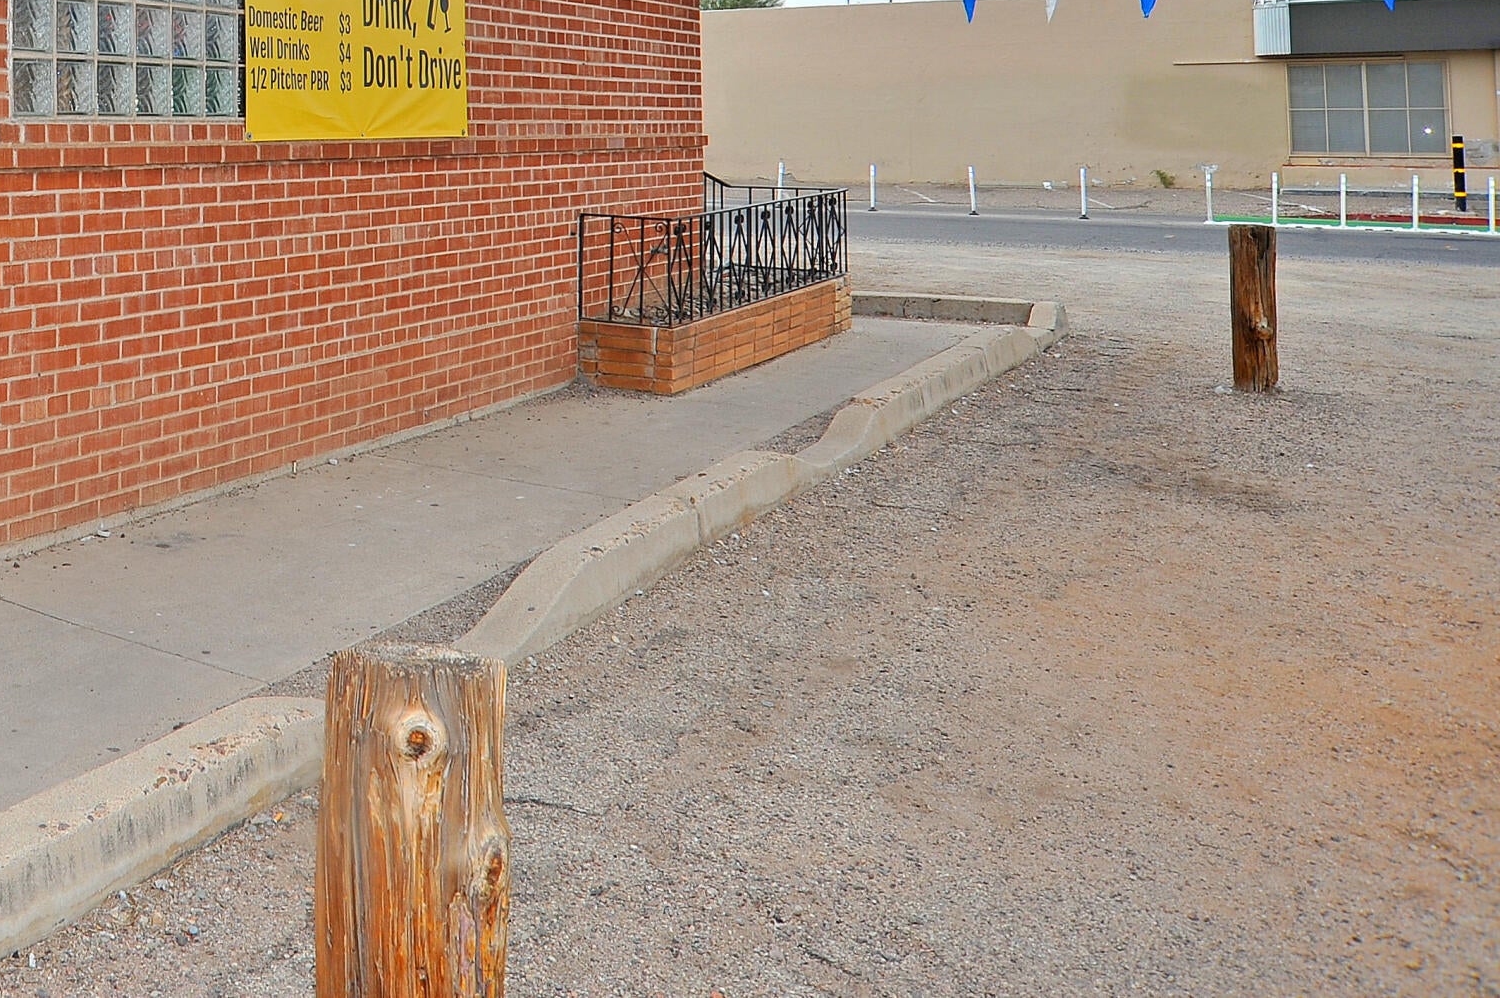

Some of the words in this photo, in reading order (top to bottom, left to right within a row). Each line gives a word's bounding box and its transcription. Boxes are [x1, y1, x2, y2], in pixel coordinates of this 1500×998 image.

[248, 5, 298, 29] Domestic
[300, 10, 324, 33] Beer
[339, 11, 352, 37] $3
[249, 36, 274, 60] Well
[276, 38, 311, 62] Drinks
[339, 40, 352, 64] $4
[250, 66, 268, 94] 1/2
[270, 69, 308, 91] Pitcher
[310, 71, 330, 92] PBR
[340, 71, 353, 95] $3
[362, 44, 414, 90] Don't
[418, 46, 463, 90] Drive
